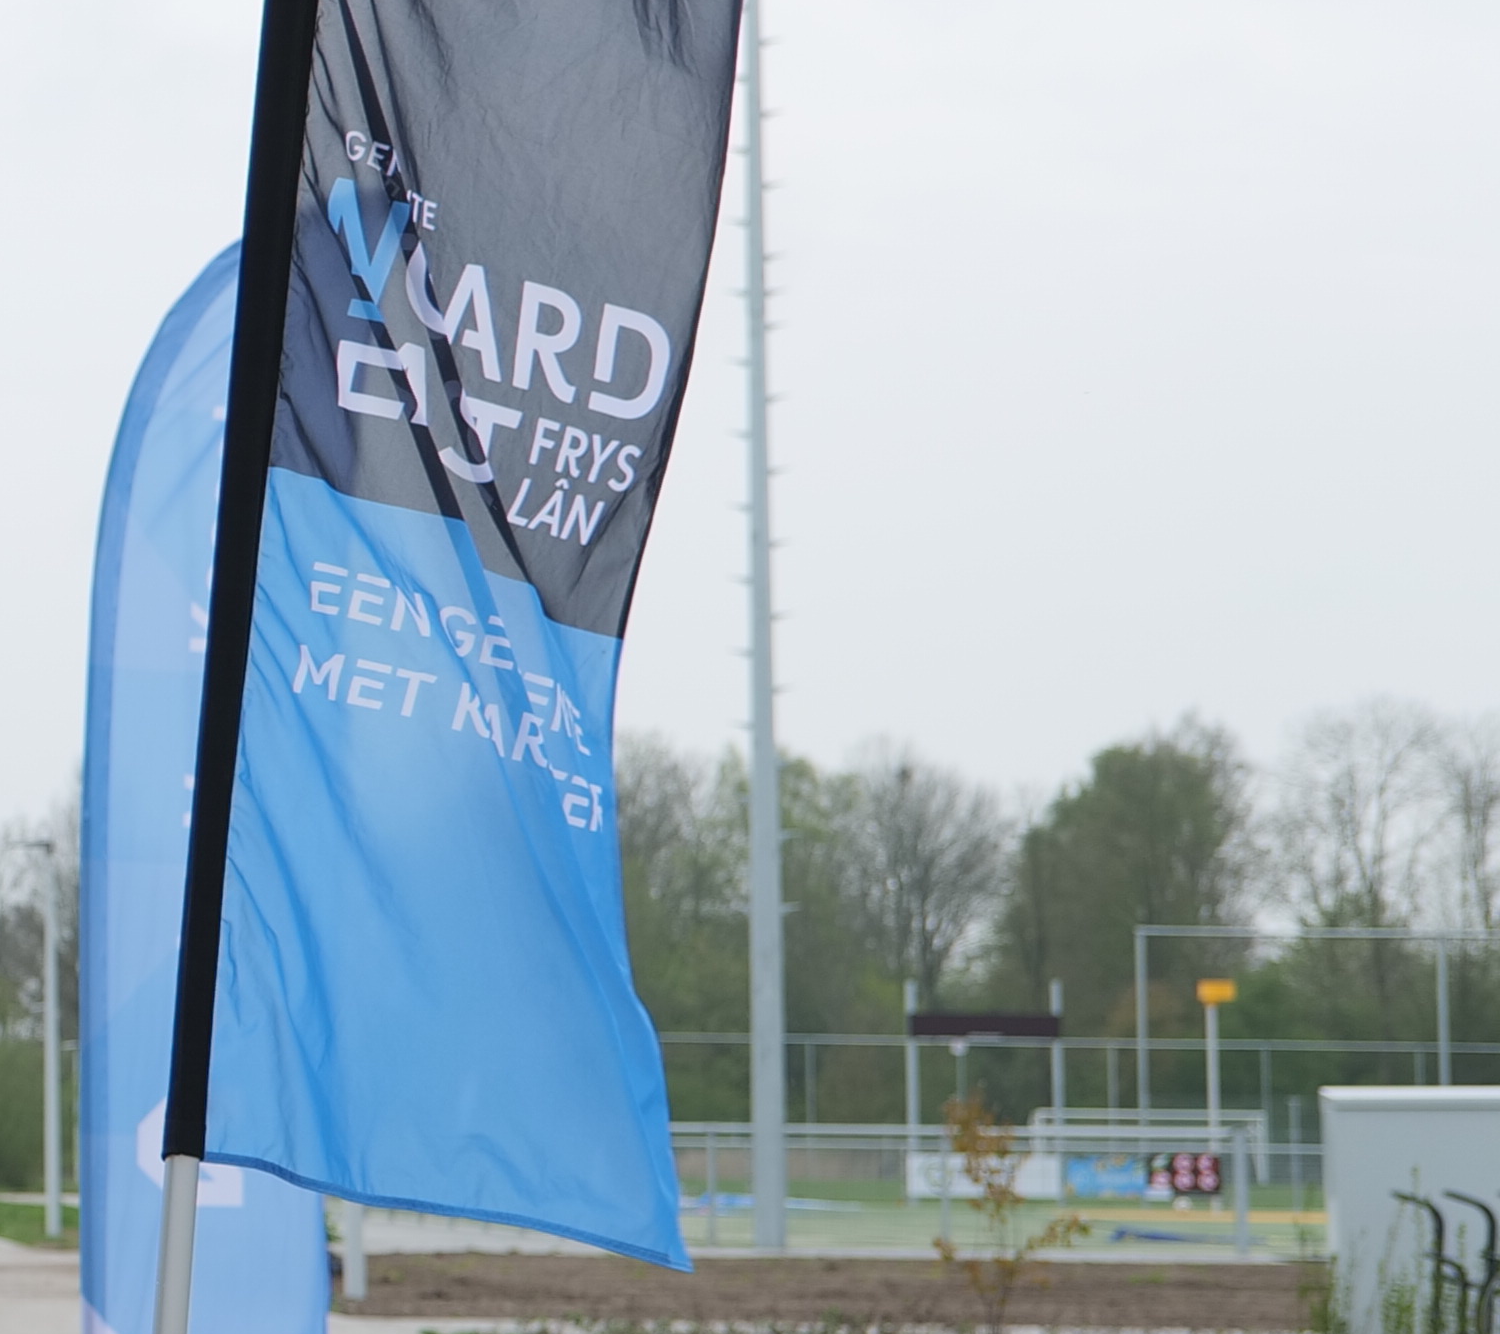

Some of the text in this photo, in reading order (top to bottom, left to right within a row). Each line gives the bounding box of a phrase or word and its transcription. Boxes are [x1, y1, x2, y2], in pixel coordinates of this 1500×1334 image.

[528, 418, 641, 493] FRYS
[506, 477, 605, 547] LÂN
[310, 561, 431, 637] EEN
[292, 644, 438, 718] MET
